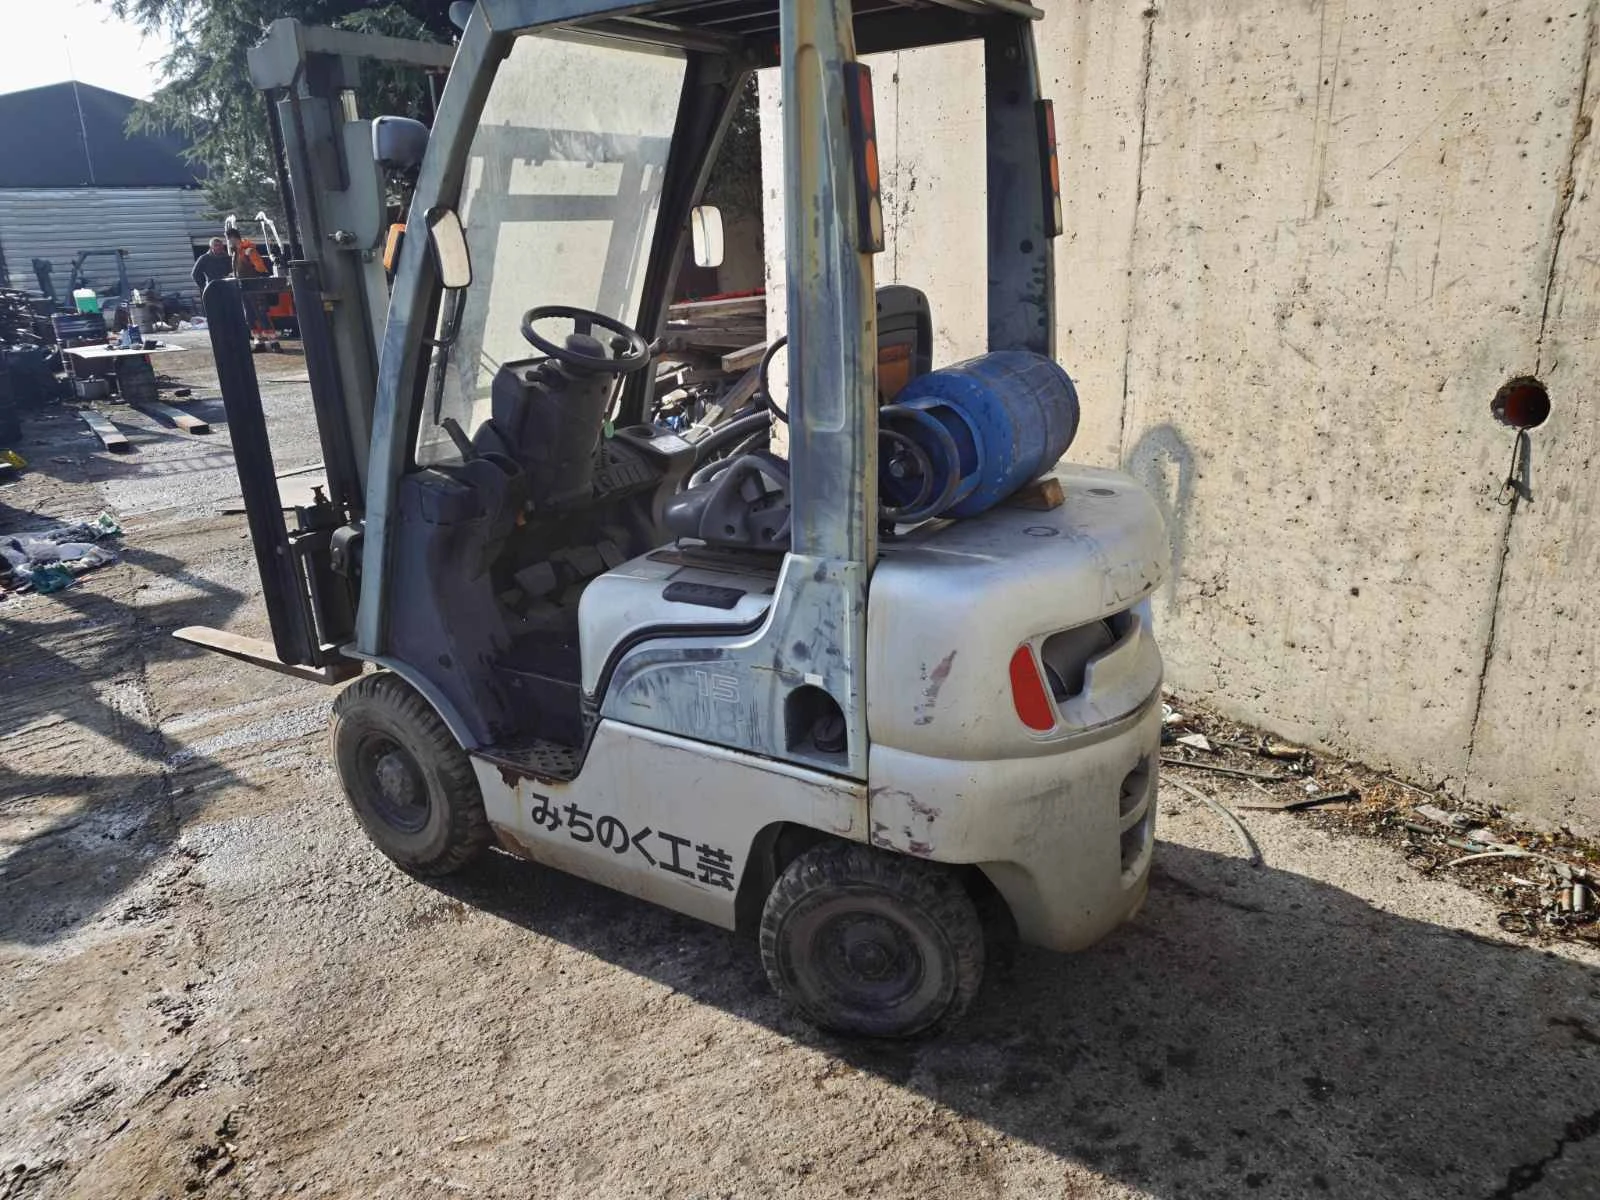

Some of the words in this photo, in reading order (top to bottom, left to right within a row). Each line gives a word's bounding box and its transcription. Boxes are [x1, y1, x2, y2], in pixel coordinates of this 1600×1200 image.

[695, 670, 740, 703] 15
[532, 792, 735, 891] みちのく工芸
